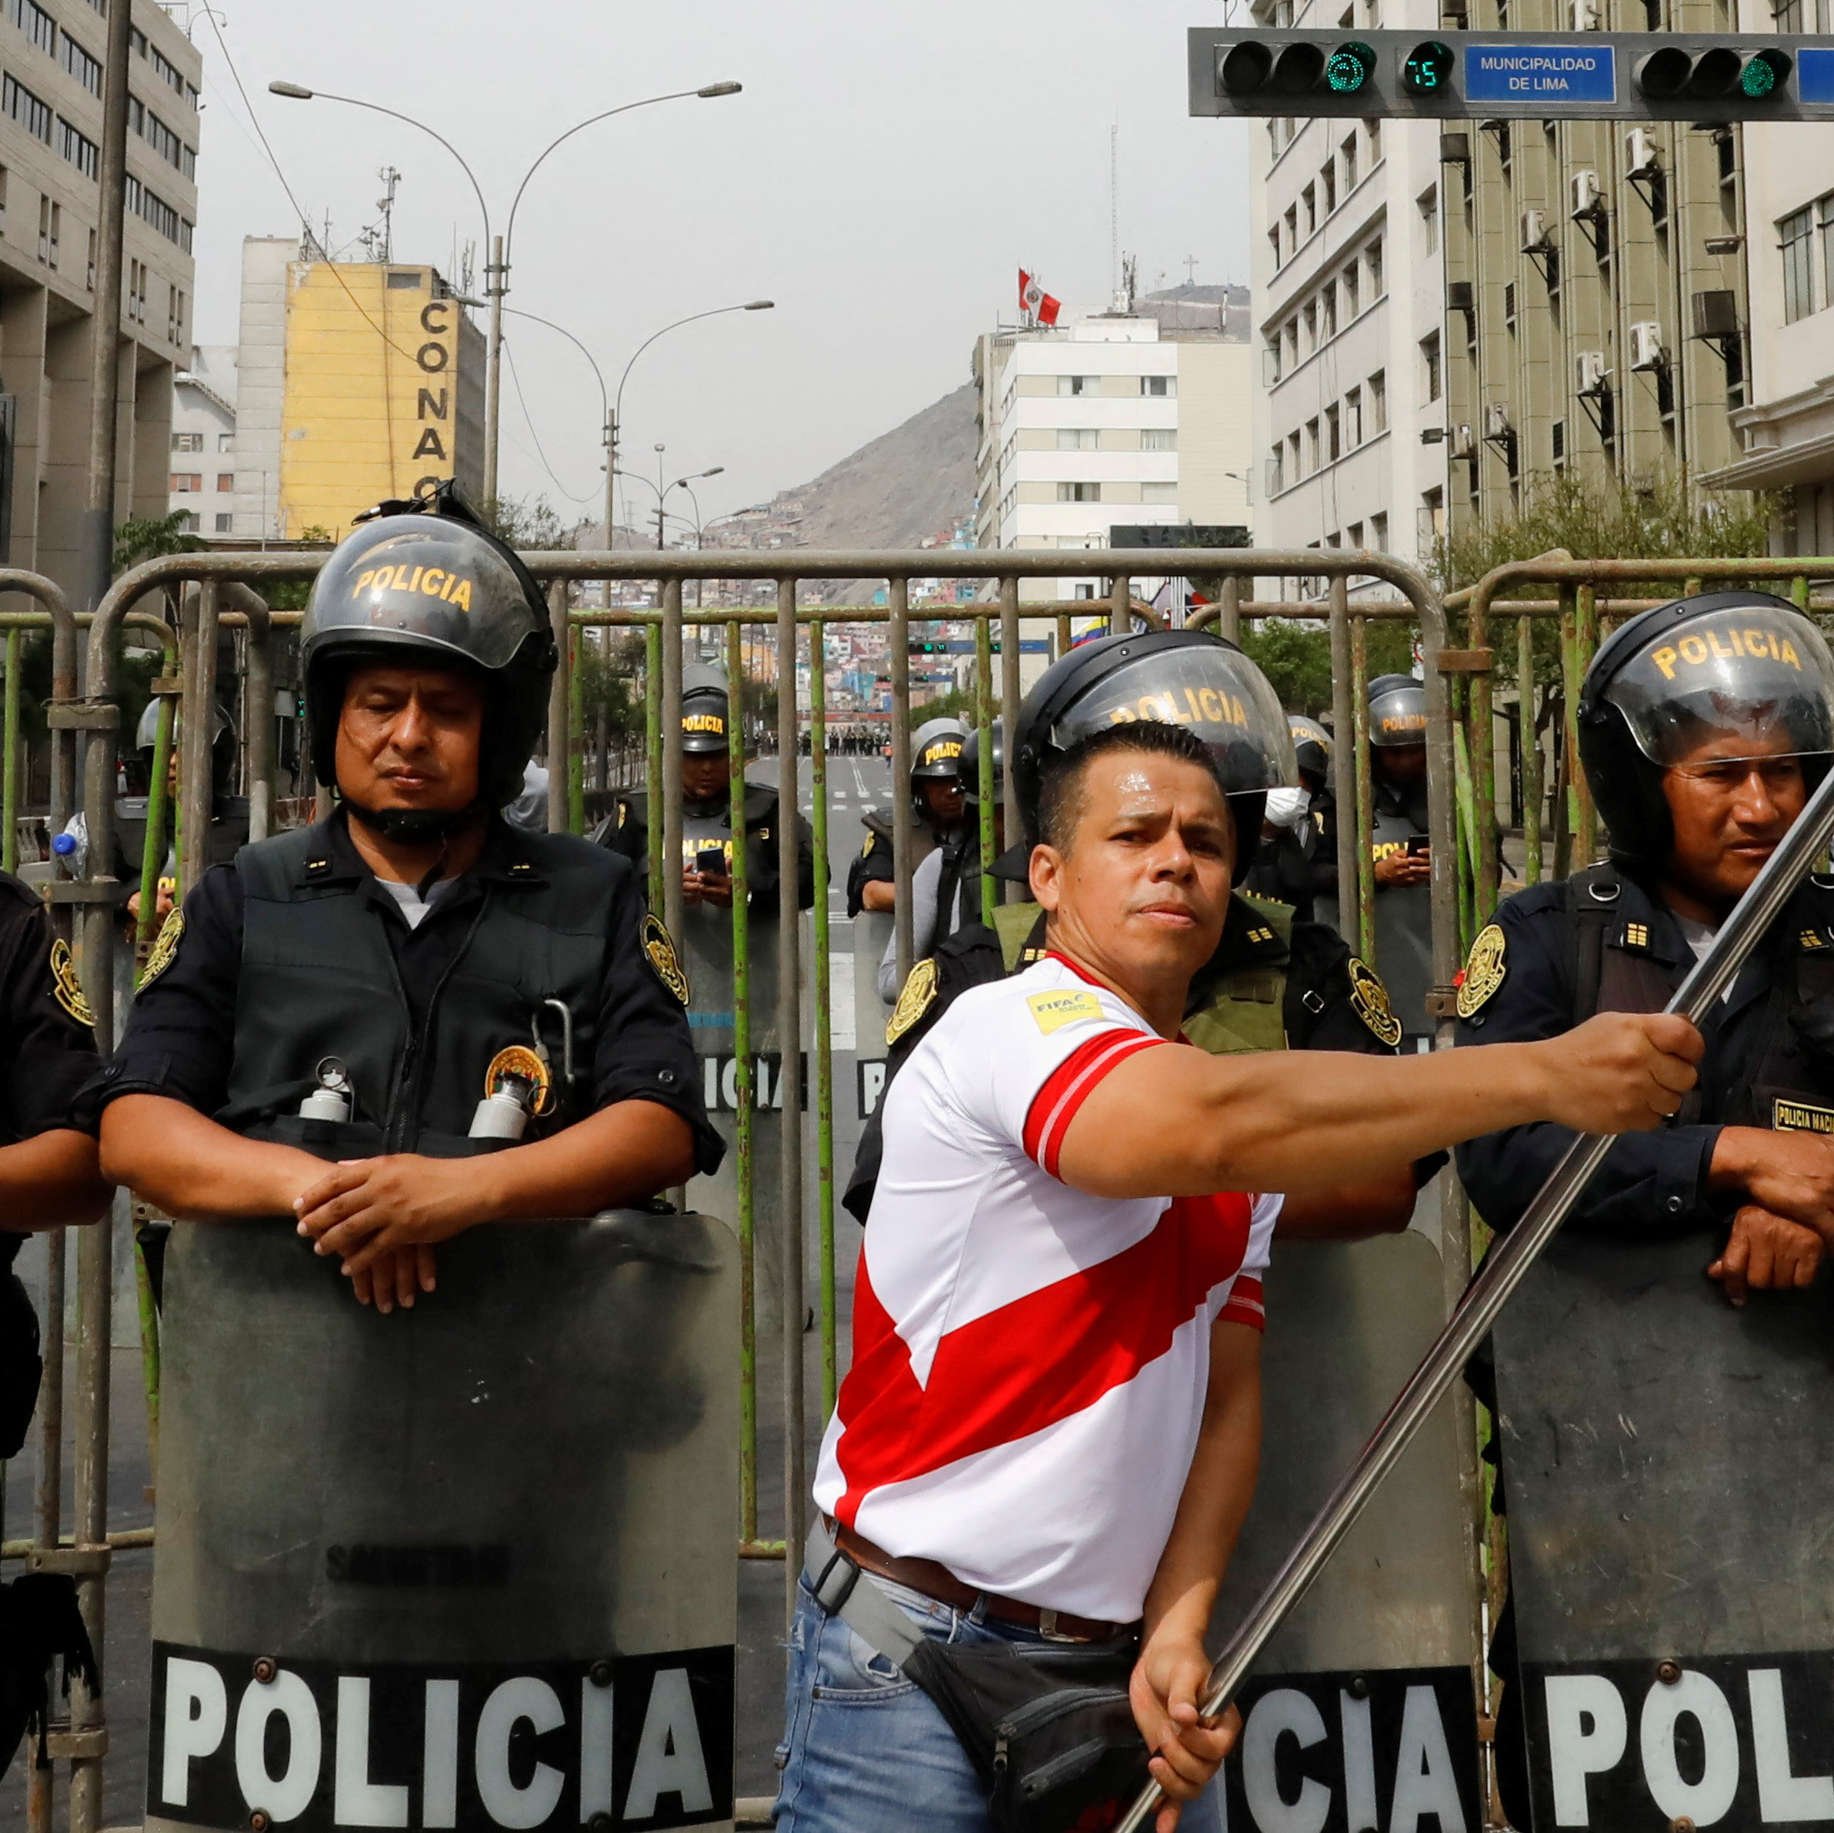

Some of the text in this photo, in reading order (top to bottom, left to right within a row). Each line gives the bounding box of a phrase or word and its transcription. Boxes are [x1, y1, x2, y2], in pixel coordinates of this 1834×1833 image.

[1480, 57, 1597, 71] MUNICIPALIDAD
[1509, 77, 1569, 91] DE LIMA
[352, 564, 473, 613] POLICIA
[1651, 627, 1802, 681] POLICIA
[1109, 687, 1249, 731] POLICIA
[925, 741, 964, 766] POLIC
[1036, 998, 1073, 1013] FIFA
[1777, 1106, 1810, 1128] POLICIA
[160, 1656, 714, 1832] POLICIA
